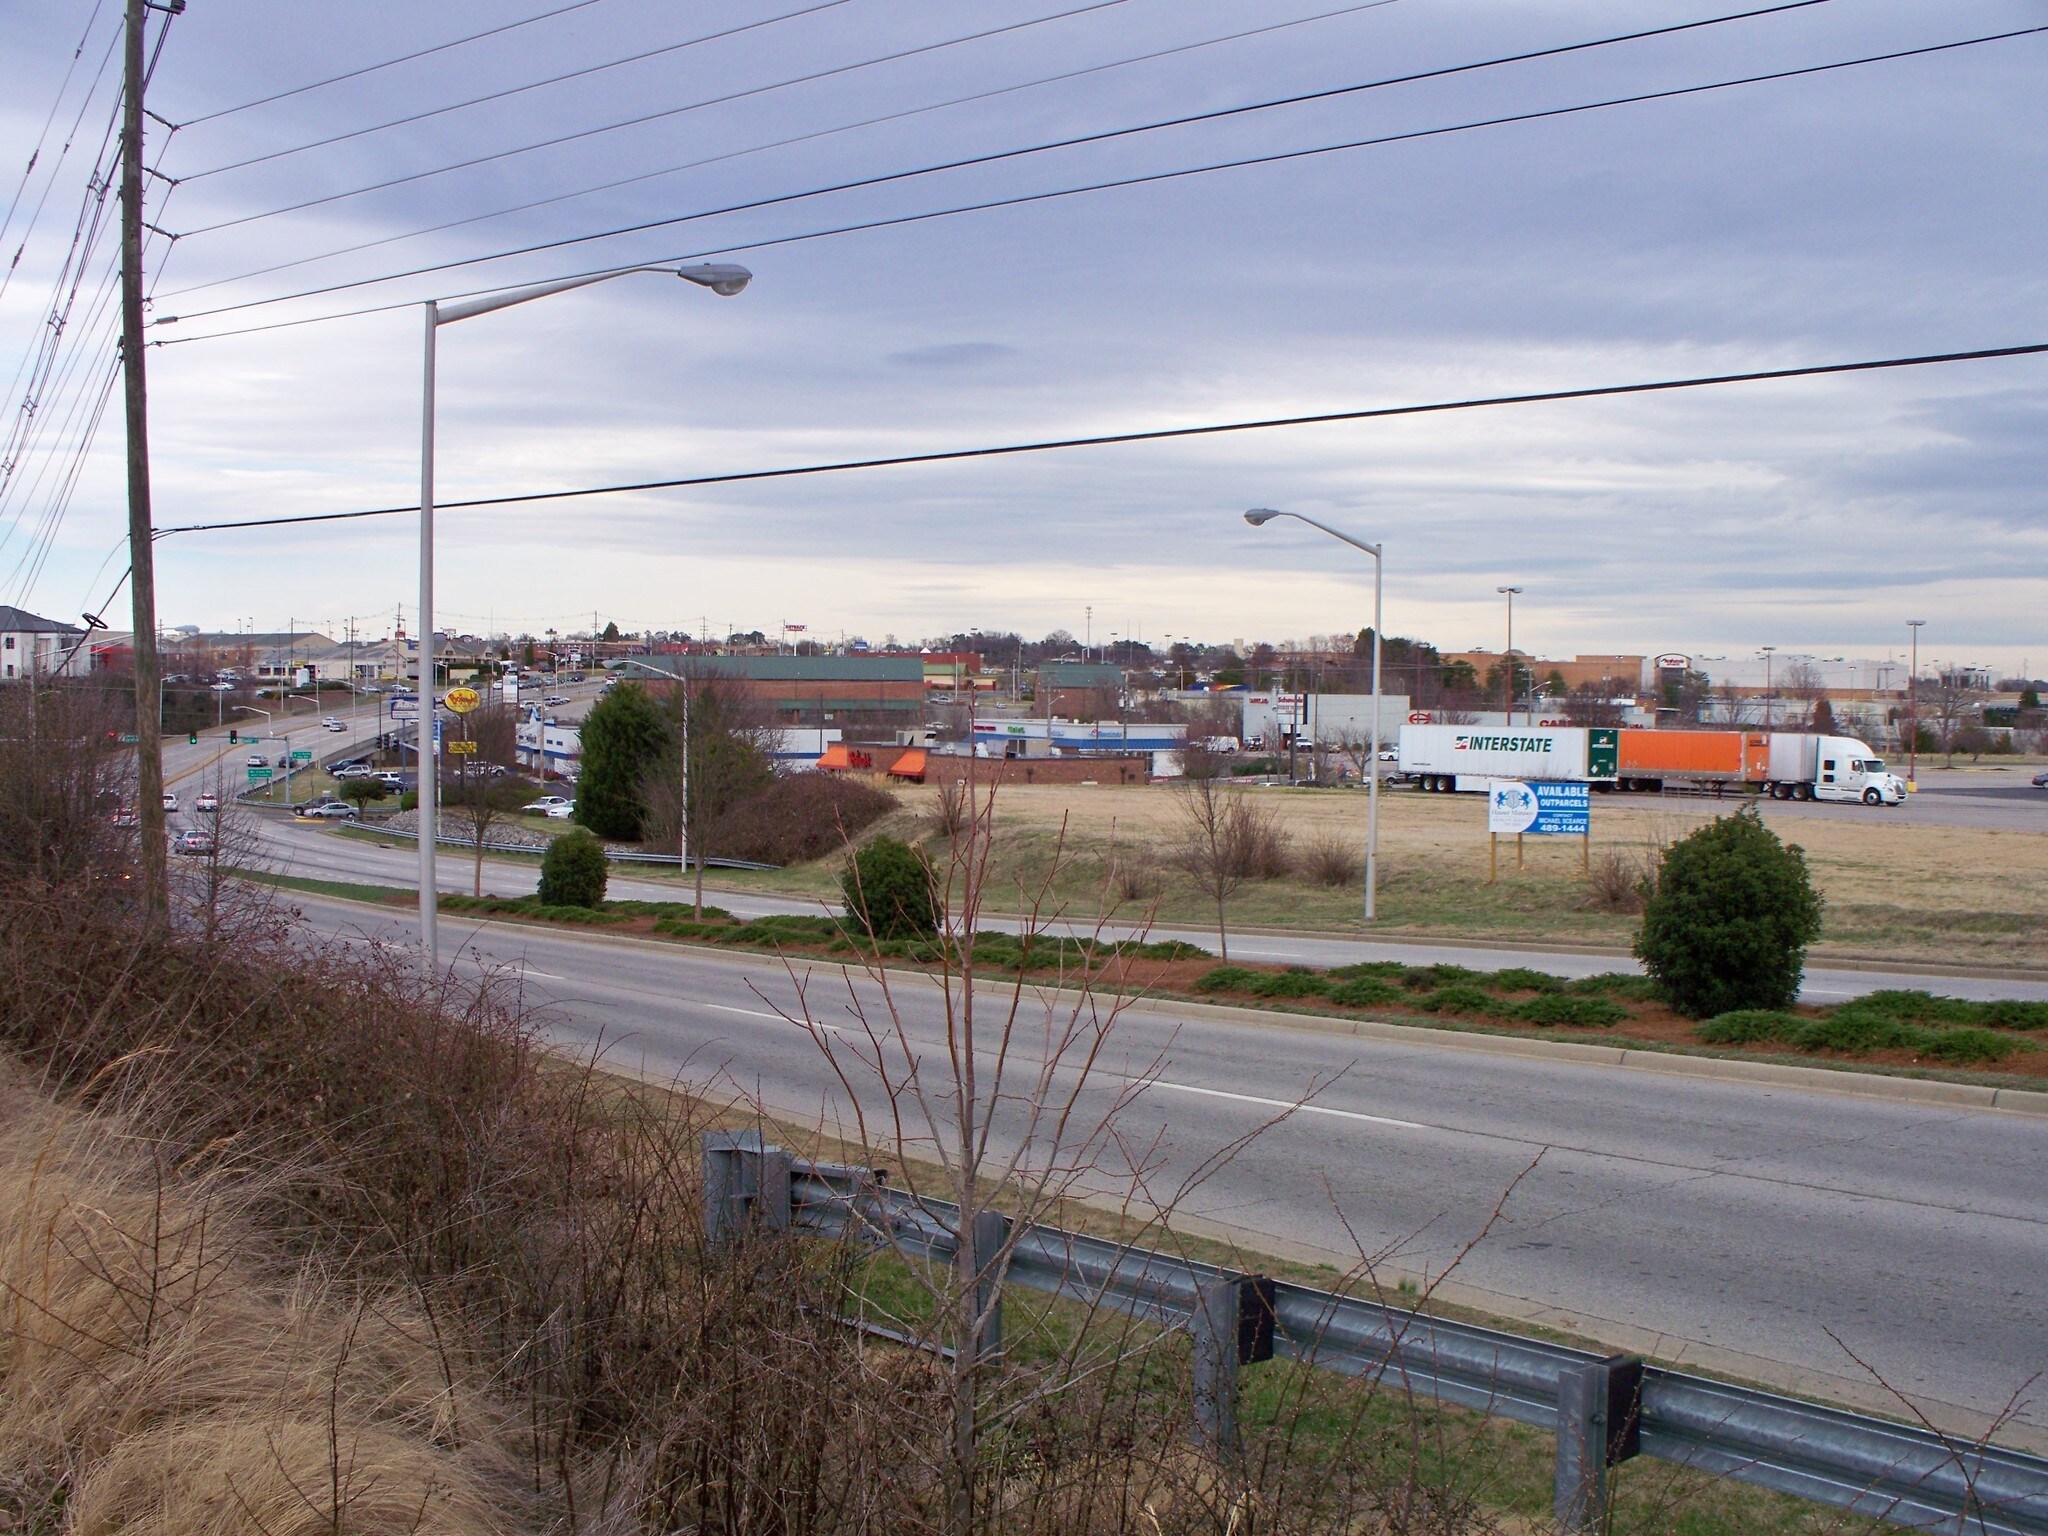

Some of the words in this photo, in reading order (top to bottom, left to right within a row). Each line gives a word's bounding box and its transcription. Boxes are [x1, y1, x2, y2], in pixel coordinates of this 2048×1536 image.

[1469, 736, 1553, 752] INTERSTATE
[1537, 785, 1589, 797] AVAILABLE
[1540, 799, 1588, 807] OUTPARCELS
[1540, 824, 1585, 832] 489-1444
